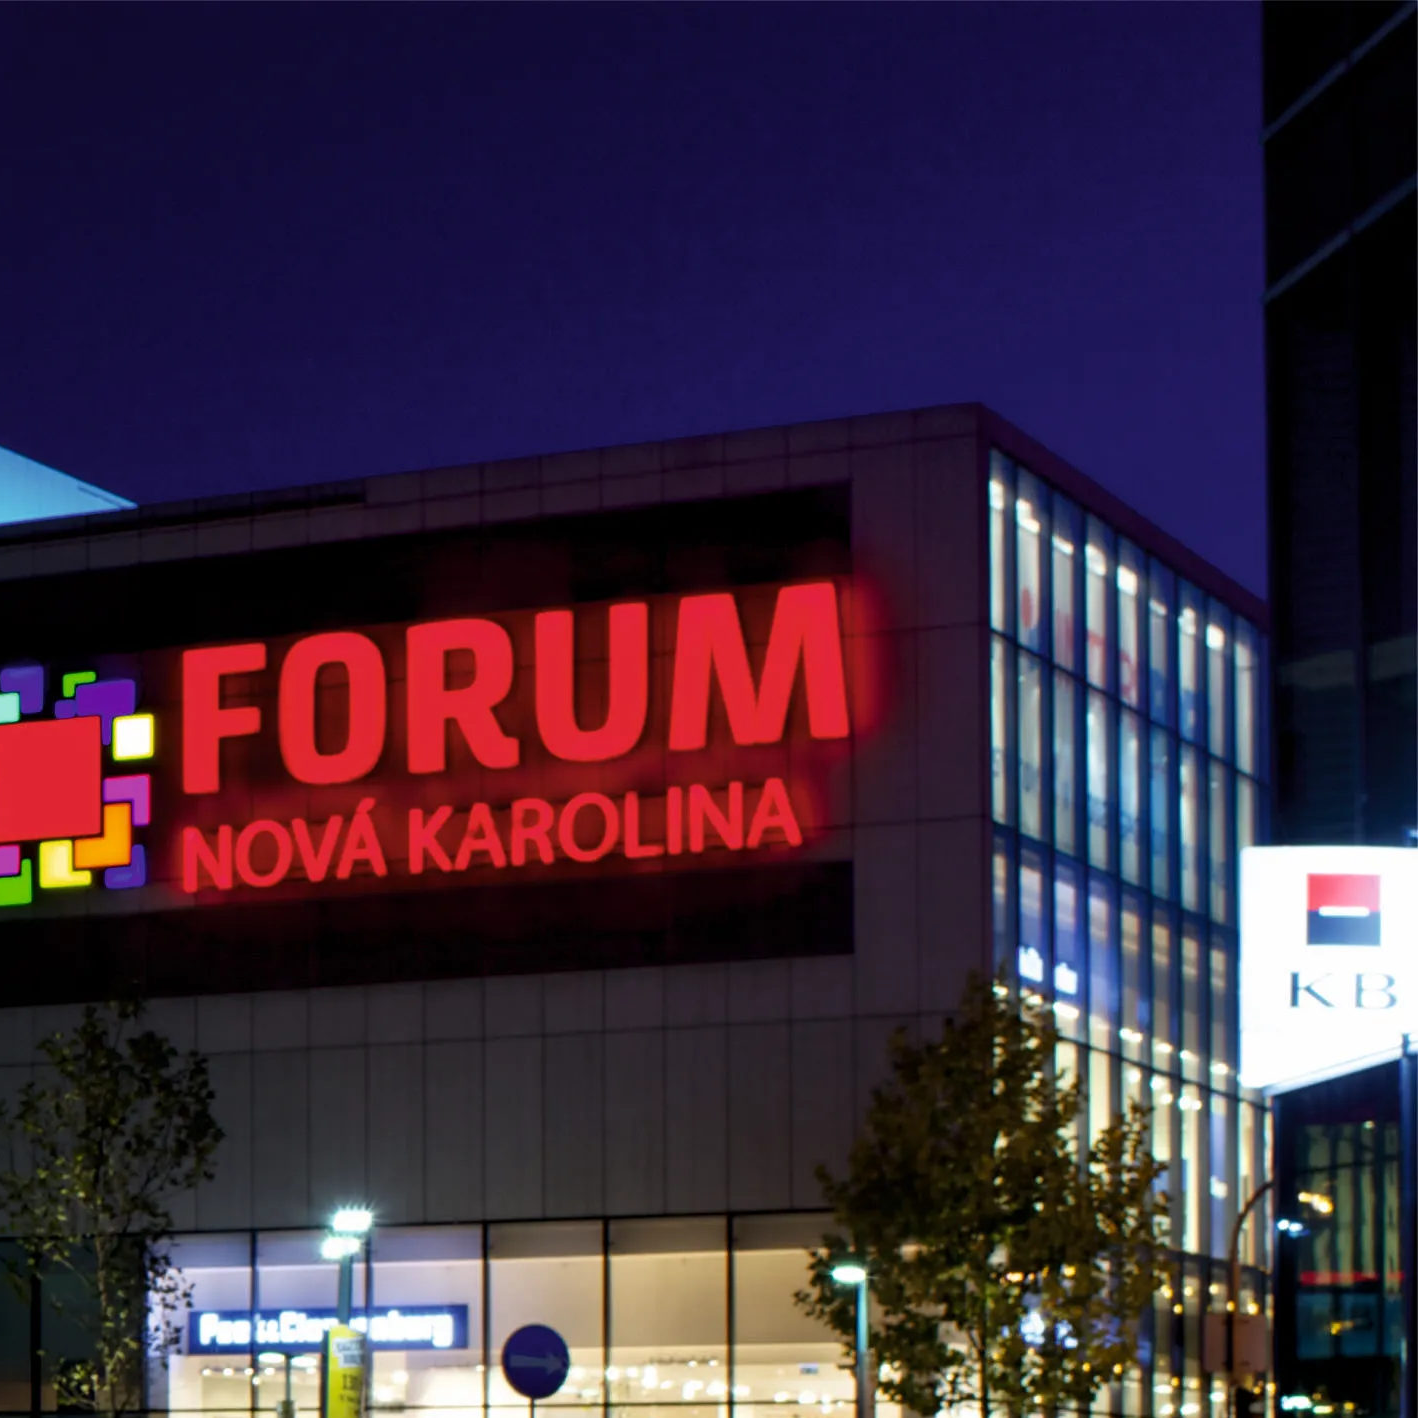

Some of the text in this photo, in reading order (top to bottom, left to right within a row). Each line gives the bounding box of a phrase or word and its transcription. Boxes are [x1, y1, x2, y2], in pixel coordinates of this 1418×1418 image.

[182, 582, 850, 794] FORUM
[182, 777, 803, 893] NOVÁ KAROLINA
[1289, 971, 1399, 1010] KB
